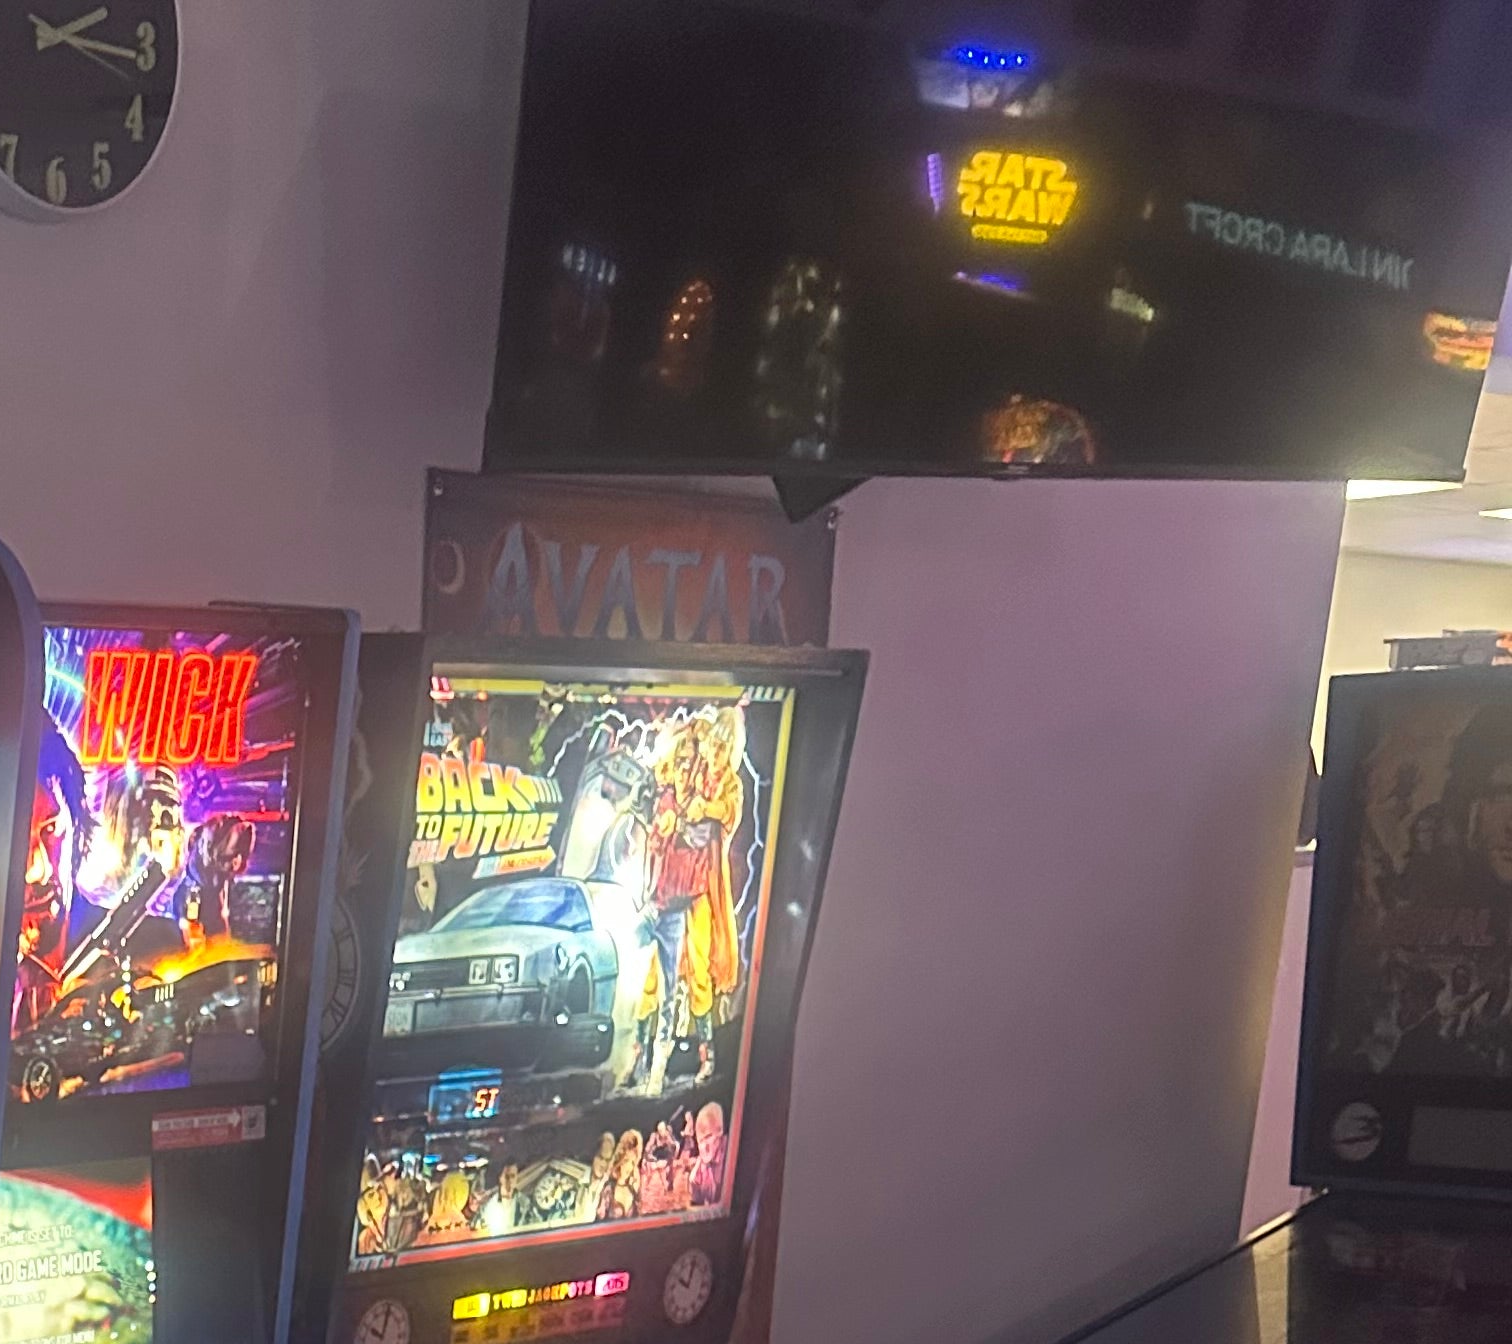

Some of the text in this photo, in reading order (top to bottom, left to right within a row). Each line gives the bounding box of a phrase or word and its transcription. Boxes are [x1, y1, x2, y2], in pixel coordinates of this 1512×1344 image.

[136, 22, 157, 72] 3
[125, 93, 144, 142] 4
[46, 156, 67, 204] 6
[92, 143, 110, 191] 5
[490, 520, 788, 645] AVATAR
[81, 650, 258, 765] WICK
[416, 751, 536, 813] BACK
[415, 812, 559, 862] TO FUTURE
[15, 1255, 59, 1282] GAME
[61, 1249, 104, 1277] MODE
